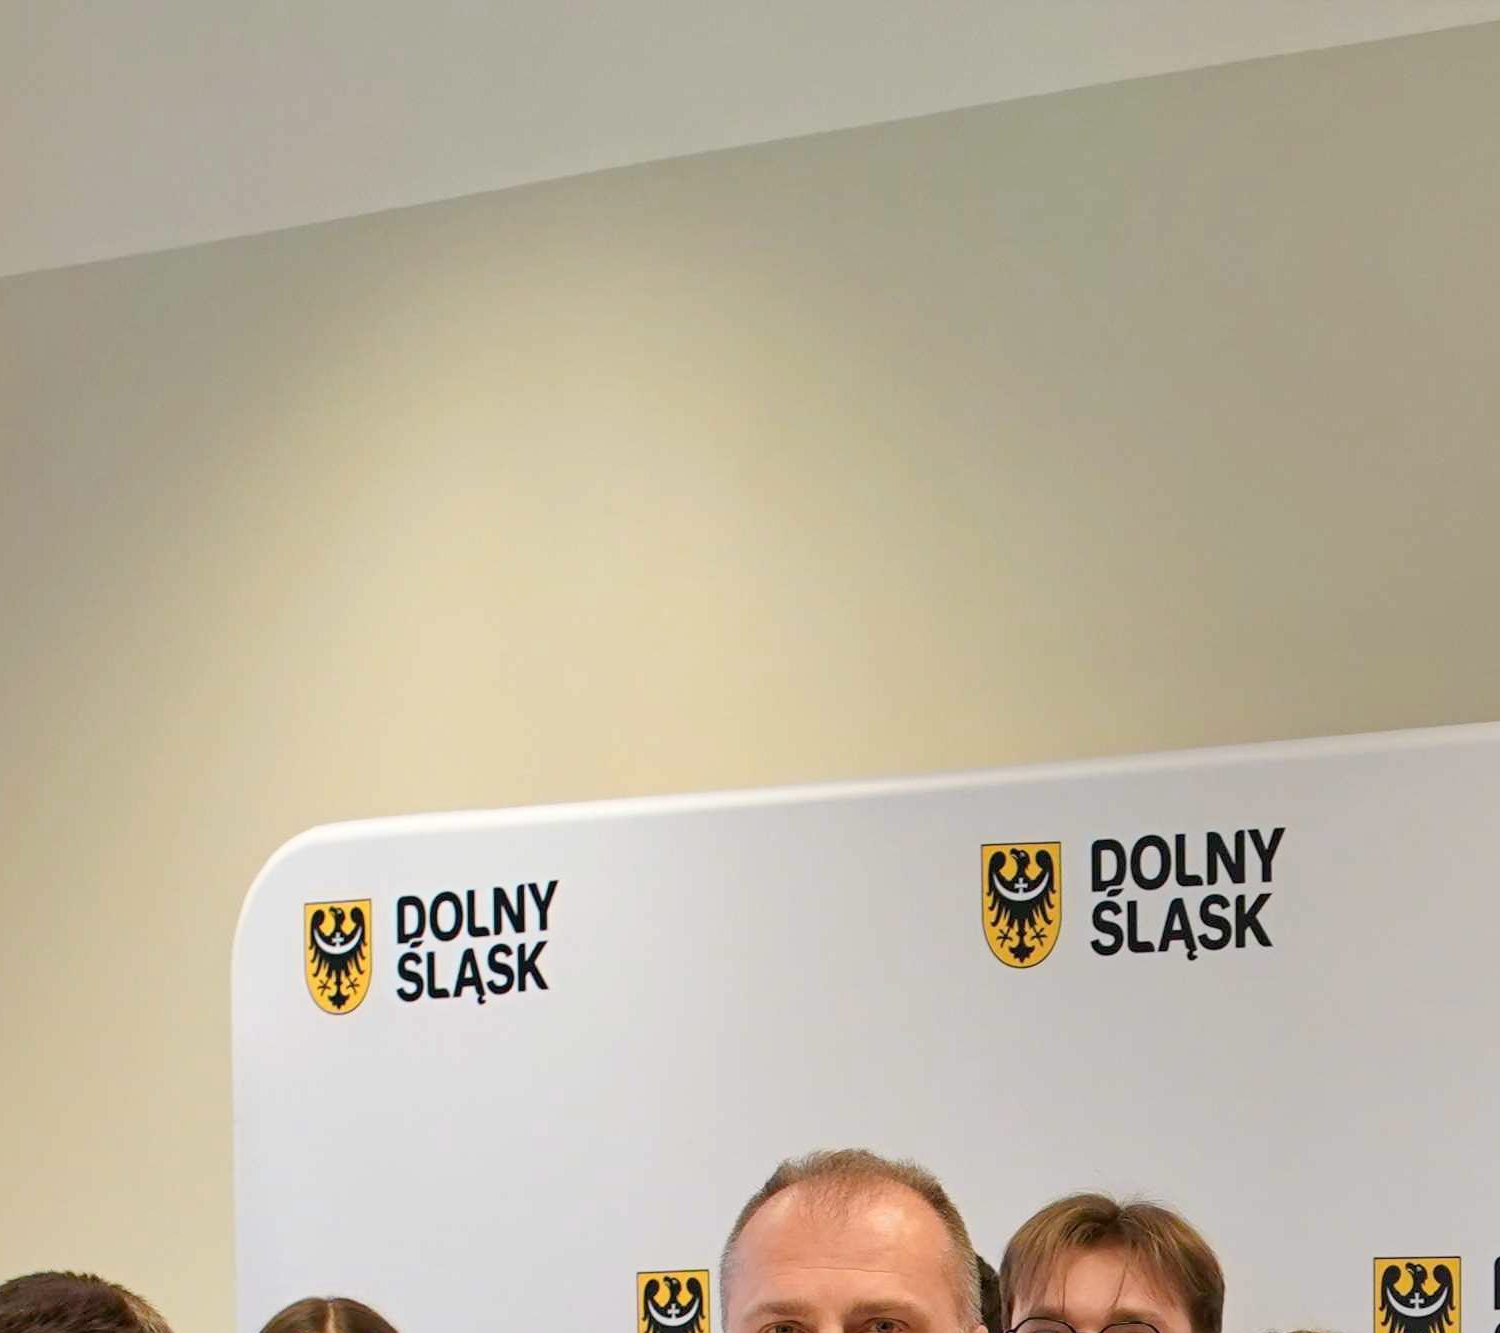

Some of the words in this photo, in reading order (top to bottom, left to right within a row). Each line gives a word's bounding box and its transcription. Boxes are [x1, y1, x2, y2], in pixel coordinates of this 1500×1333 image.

[1092, 828, 1285, 892] DOLNY
[398, 880, 557, 943] DOLNY
[1091, 889, 1272, 961] ŚLĄSK
[397, 940, 548, 1004] ŚLĄSK
